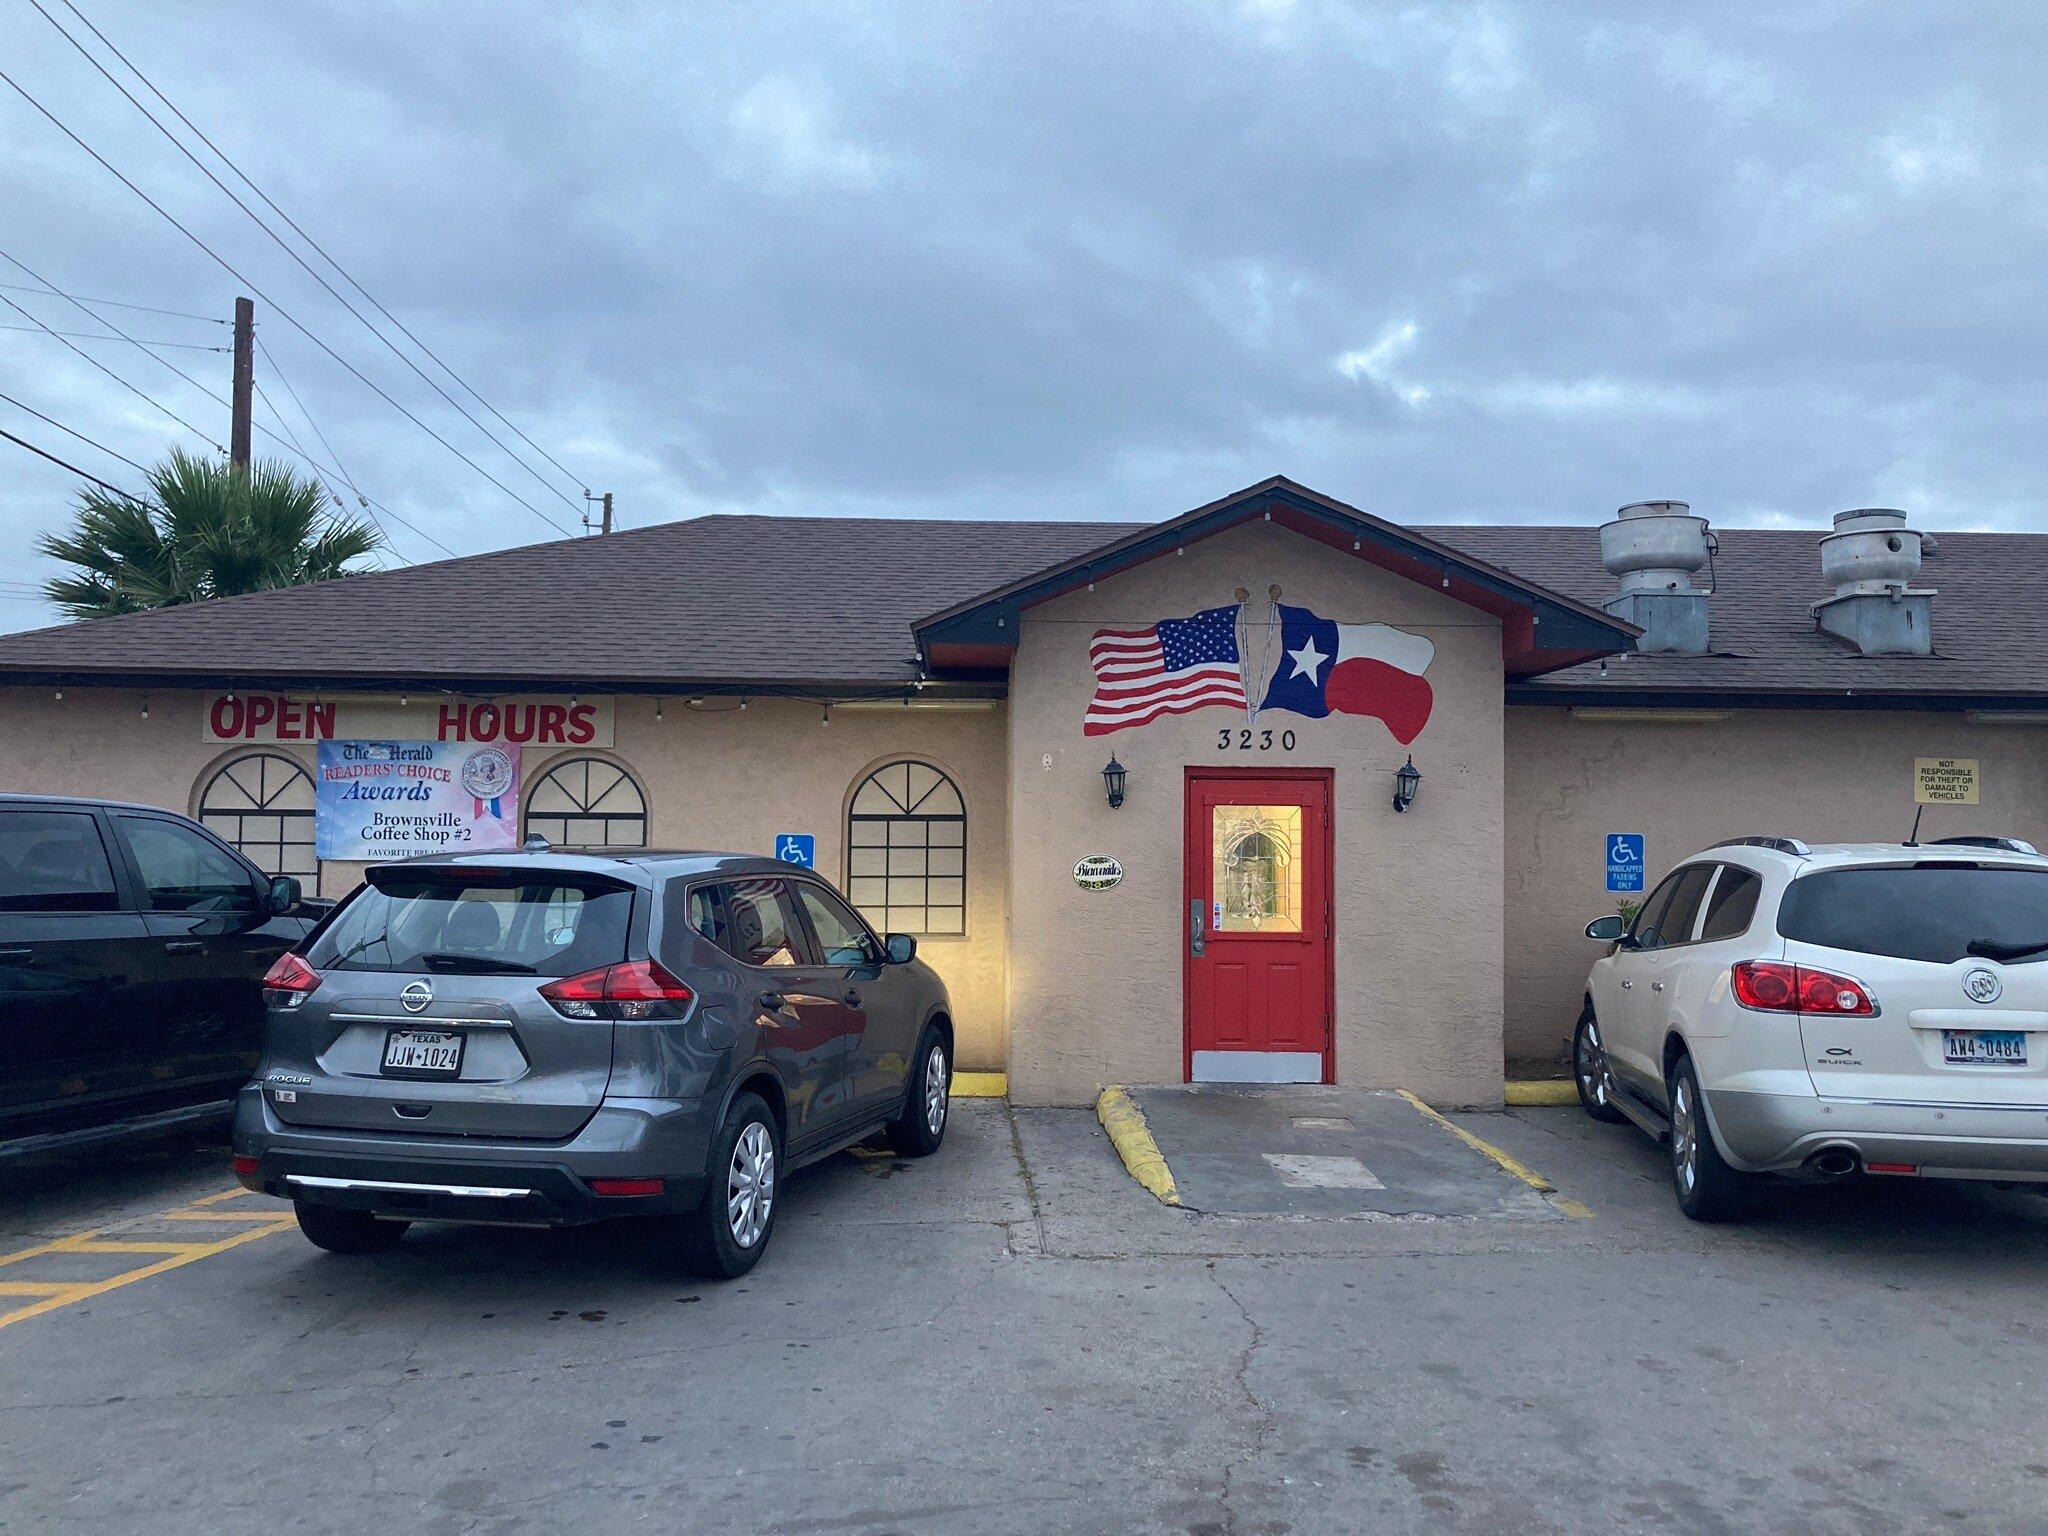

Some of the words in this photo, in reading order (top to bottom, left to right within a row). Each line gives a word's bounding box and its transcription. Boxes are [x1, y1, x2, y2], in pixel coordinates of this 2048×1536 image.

[211, 696, 336, 739] OPEN
[437, 703, 597, 744] HOURS
[1218, 729, 1295, 751] 3230
[343, 745, 369, 760] The
[389, 745, 433, 761] Herald
[398, 764, 451, 783] CHOICE
[1921, 768, 1973, 777] RESPONSIBLE
[341, 780, 432, 801] Awards
[1924, 784, 1957, 792] DAMAGE
[1928, 792, 1965, 800] VEHICLES
[373, 812, 462, 827] Brownsville
[361, 826, 410, 841] Coffee
[414, 826, 450, 845] Shop
[454, 828, 472, 841] #2
[368, 849, 412, 857] FAVORITE
[1608, 864, 1642, 873] HANDICAPPED
[1613, 873, 1637, 881] PARKING
[1617, 881, 1632, 890] ONLY
[412, 1035, 441, 1044] TEXAS
[268, 1074, 312, 1086] ROGUE
